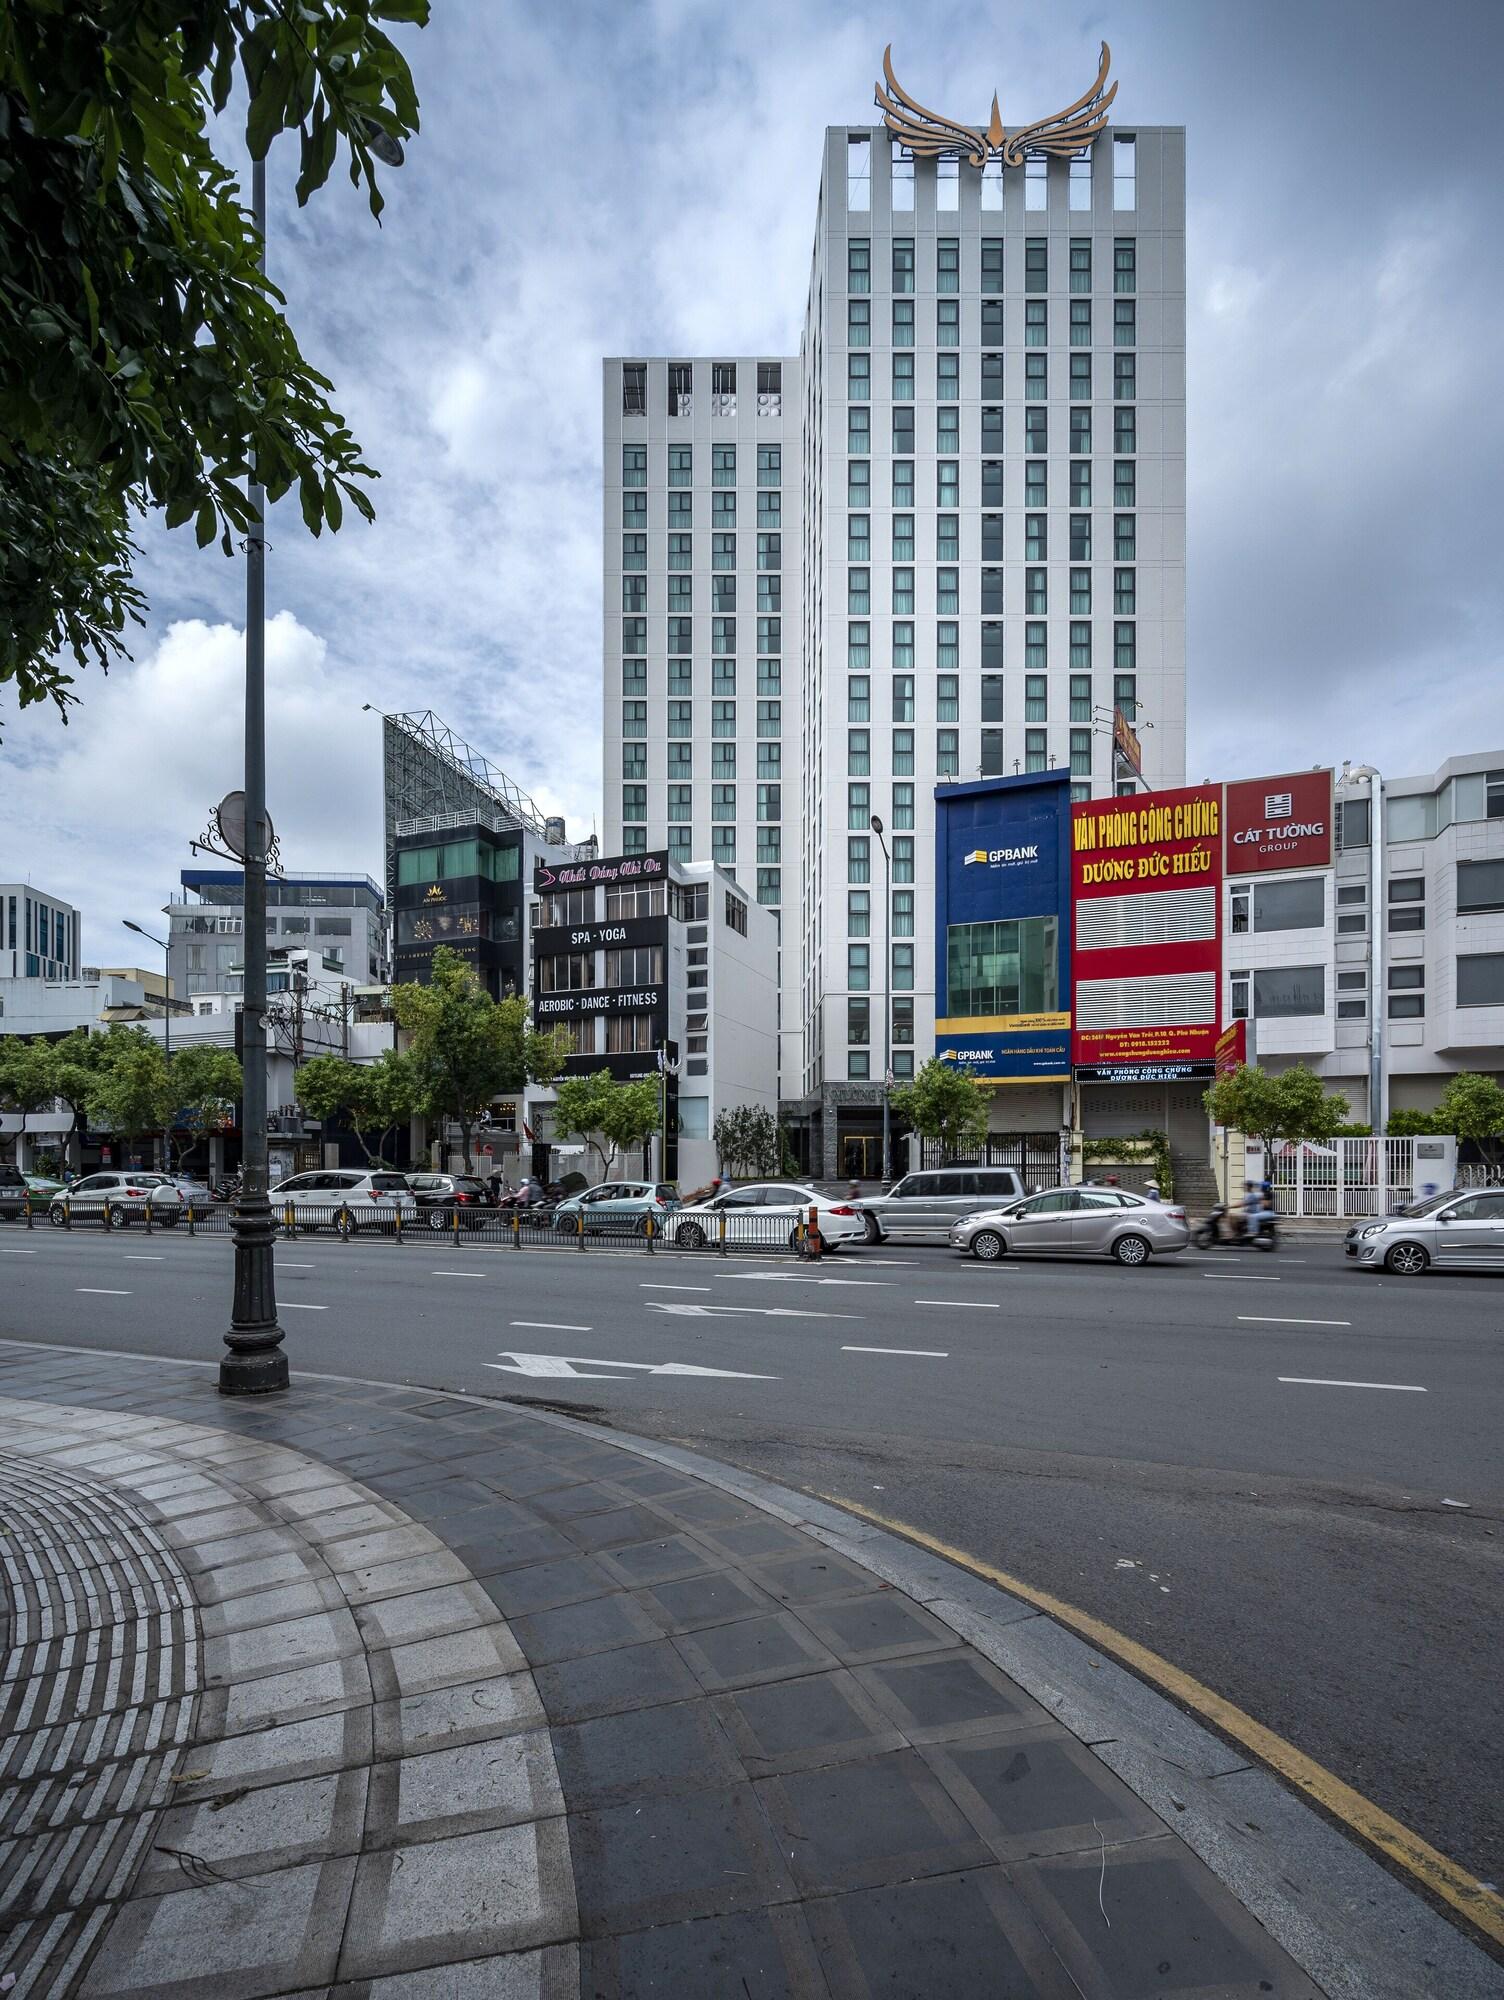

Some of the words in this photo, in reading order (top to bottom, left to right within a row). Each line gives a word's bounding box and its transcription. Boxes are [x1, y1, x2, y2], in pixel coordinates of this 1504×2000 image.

[1074, 811, 1096, 850] VĂN
[1100, 808, 1137, 848] PHÒNG
[1140, 802, 1172, 844] CÔNG
[1175, 796, 1218, 840] CHỨNG
[1234, 828, 1262, 844] CÁT
[1266, 822, 1324, 840] TƯỜNG
[989, 845, 1038, 862] GPBANK
[1259, 842, 1298, 853] GROUP
[1082, 858, 1134, 884] DƯƠNG
[1138, 851, 1169, 878] ĐỨC
[571, 931, 590, 944] SPA
[600, 928, 626, 941] YOGA
[539, 998, 574, 1012] AEROBIC
[581, 996, 610, 1010] DANCE
[618, 992, 657, 1006] FITNESS
[958, 1050, 994, 1060] GPBANK
